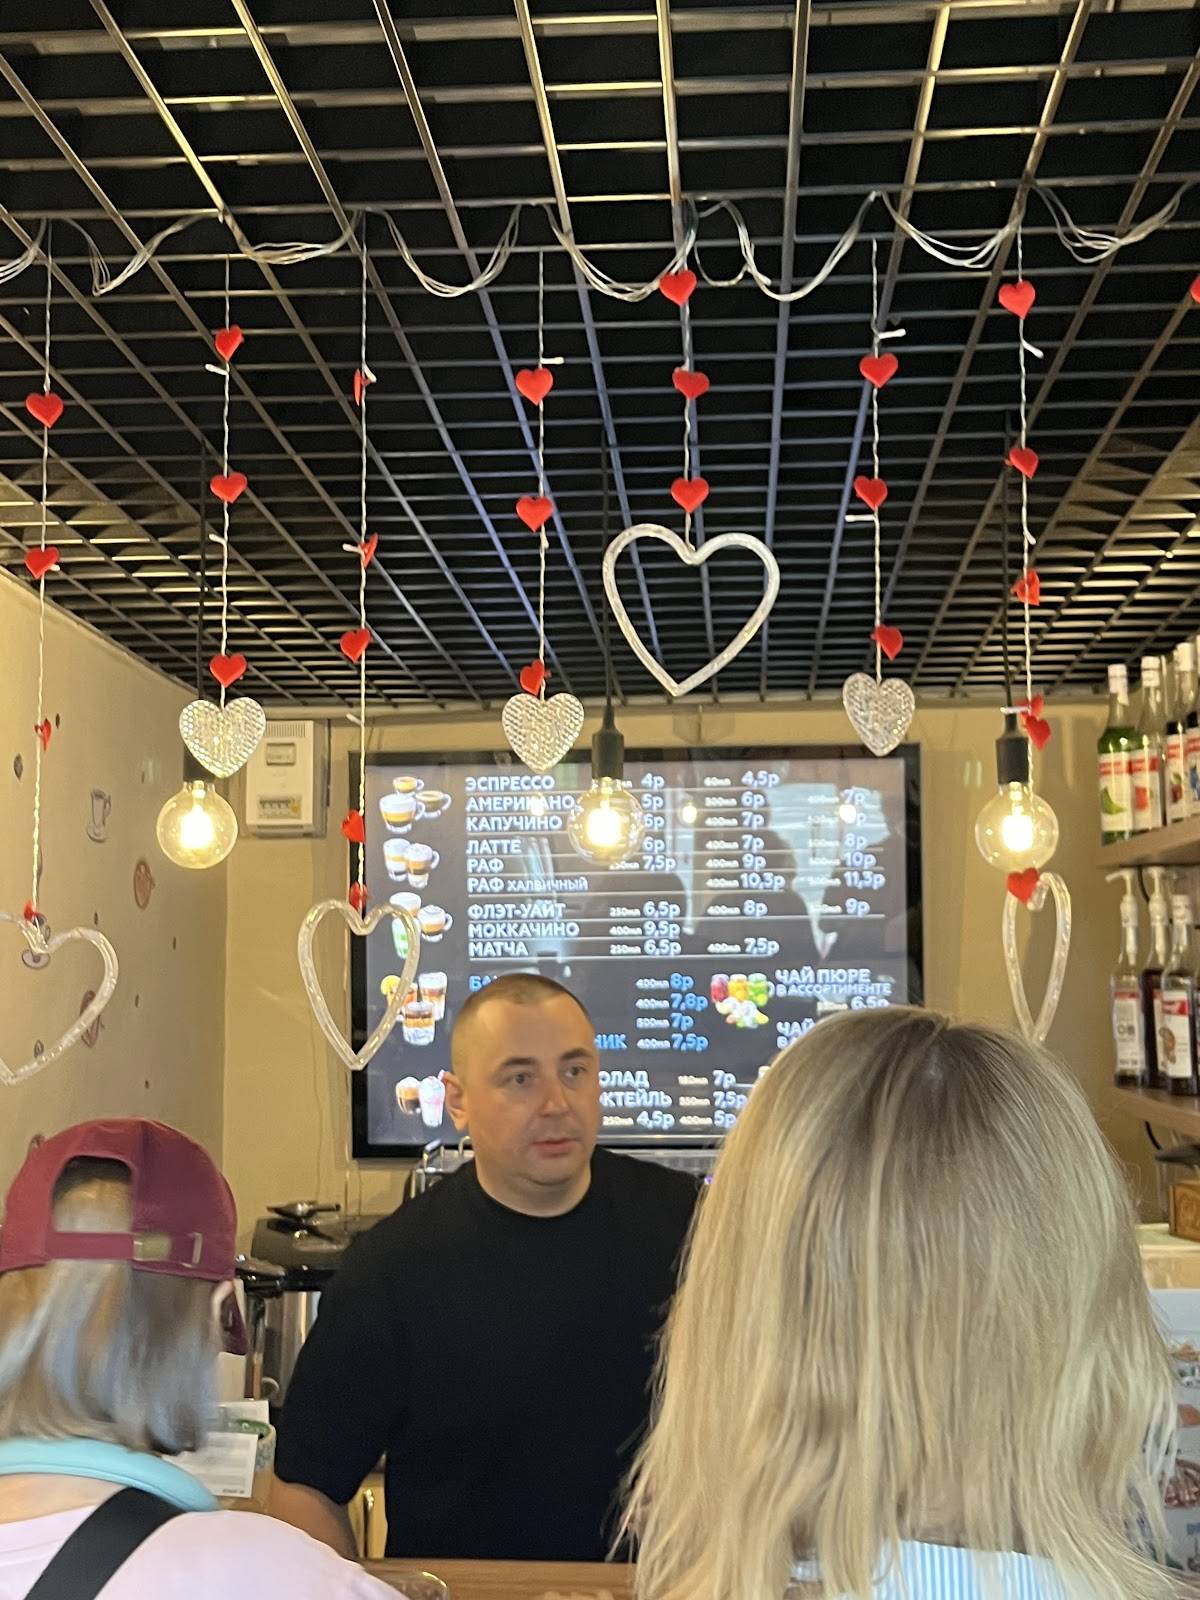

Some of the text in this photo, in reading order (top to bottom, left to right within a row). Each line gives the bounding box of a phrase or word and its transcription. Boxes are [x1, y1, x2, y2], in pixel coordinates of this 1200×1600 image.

[465, 775, 555, 792] ЭСПРЕССО
[641, 773, 665, 790] 4р
[741, 771, 780, 787] 4,5р
[642, 793, 664, 810] 5р
[741, 790, 766, 809] 6р
[466, 815, 563, 831] КАПУЧИНО
[741, 811, 764, 829] 7р
[466, 840, 522, 854] ЛАТТЕ
[644, 836, 666, 853] 6р
[741, 834, 764, 852] 7р
[467, 858, 504, 873] РАФ
[643, 855, 677, 872] 7,5р
[741, 853, 767, 871] 9р
[467, 878, 504, 892] РАФ
[468, 900, 566, 919] ФЛЭТ-УАЙТ
[643, 900, 681, 917] 6,5р
[744, 899, 768, 917] 8р
[845, 898, 870, 917] 9р
[468, 922, 580, 938] МОККАЧИНО
[643, 920, 681, 937] 9,5р
[469, 942, 528, 957] МАТЧА
[643, 939, 682, 956] 6,5р
[743, 937, 780, 955] 7,5р
[670, 972, 694, 991] 8р
[775, 966, 871, 984] ЧАЙ ПЮРЕ
[776, 983, 892, 997] В АССОРТИМЕНТЕ
[670, 992, 708, 1012] 7,8р
[670, 1012, 694, 1031] 7р
[671, 1033, 709, 1051] 7,5р
[712, 1069, 737, 1089] 7р
[599, 1088, 673, 1108] КТЕЙЛЬ
[713, 1091, 748, 1110] 7,5р
[637, 1110, 675, 1129] 4,5р
